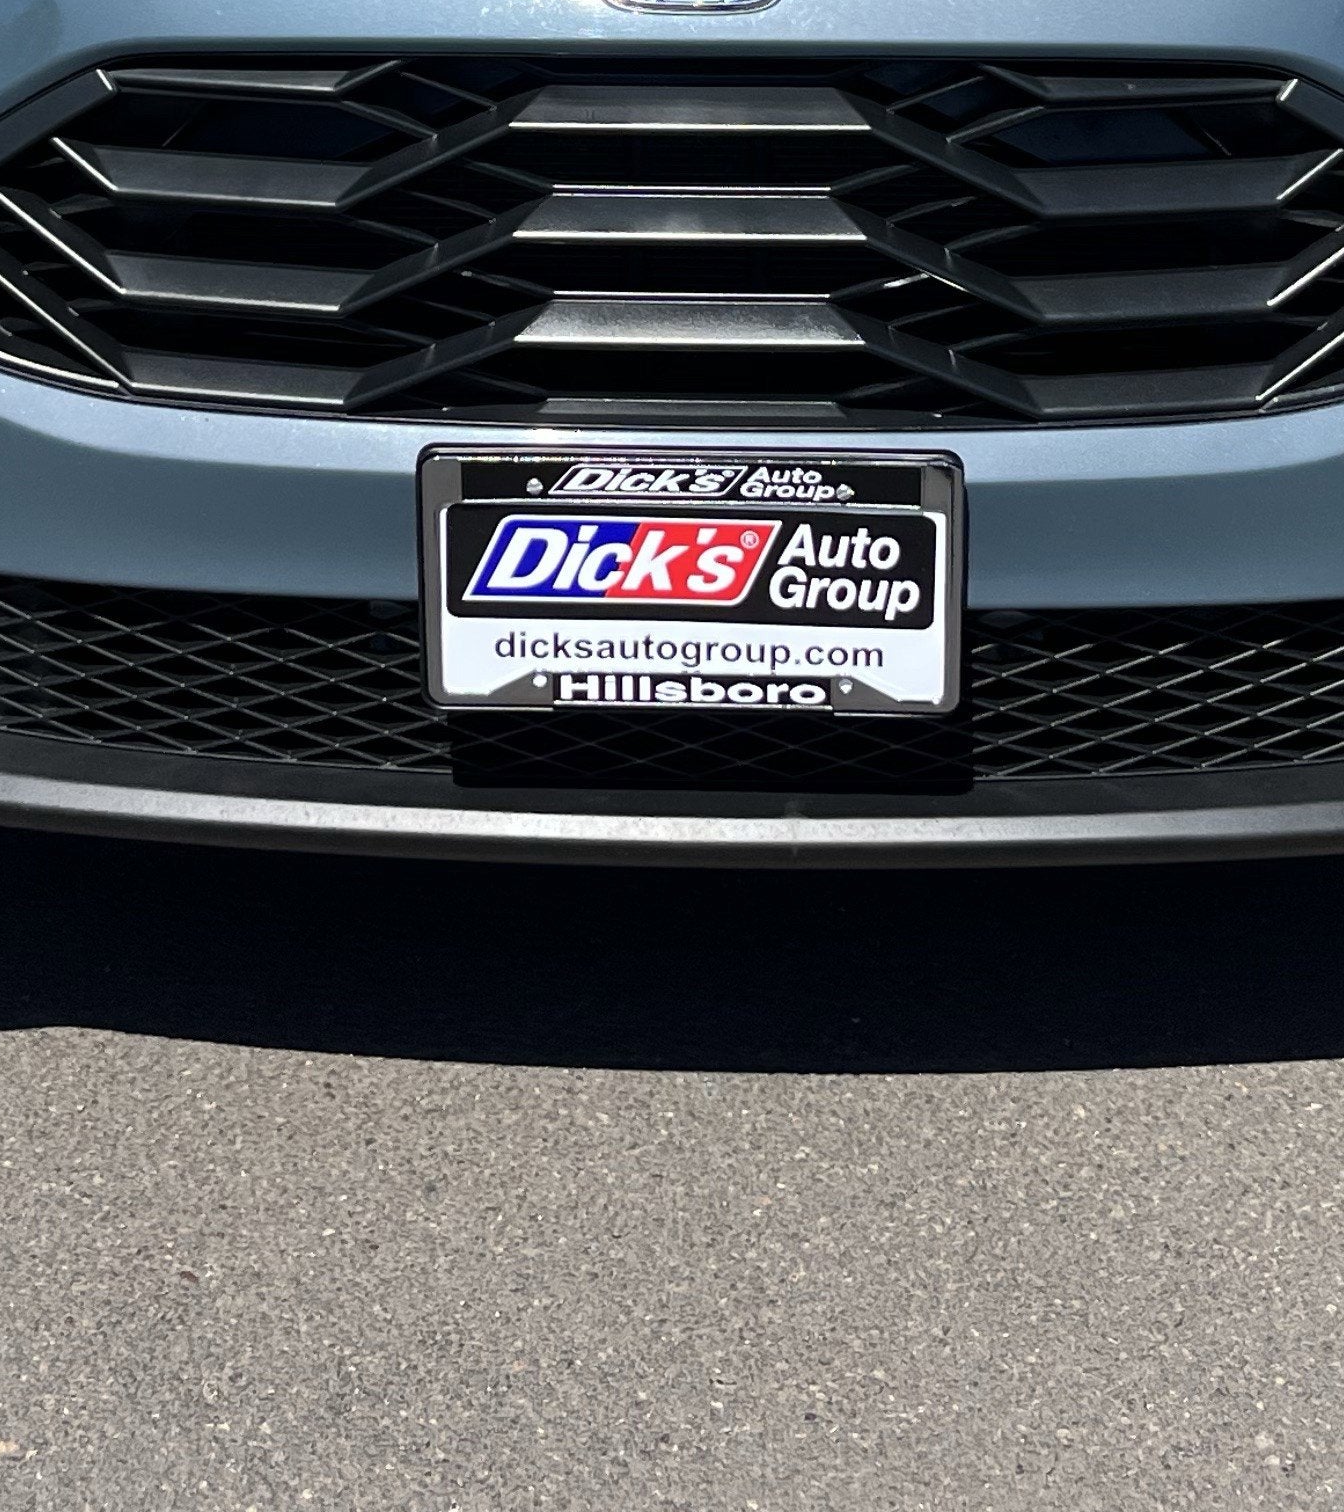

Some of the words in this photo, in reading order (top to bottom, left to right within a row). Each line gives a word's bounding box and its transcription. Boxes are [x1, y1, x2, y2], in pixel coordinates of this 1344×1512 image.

[563, 467, 726, 493] Dick's
[748, 466, 822, 485] Auto
[740, 481, 835, 501] Group
[487, 524, 745, 593] Dick's
[777, 523, 901, 570] Auto
[769, 565, 921, 621] Group
[494, 631, 885, 668] dicksautogroup.com
[559, 673, 827, 704] Hillsboro
